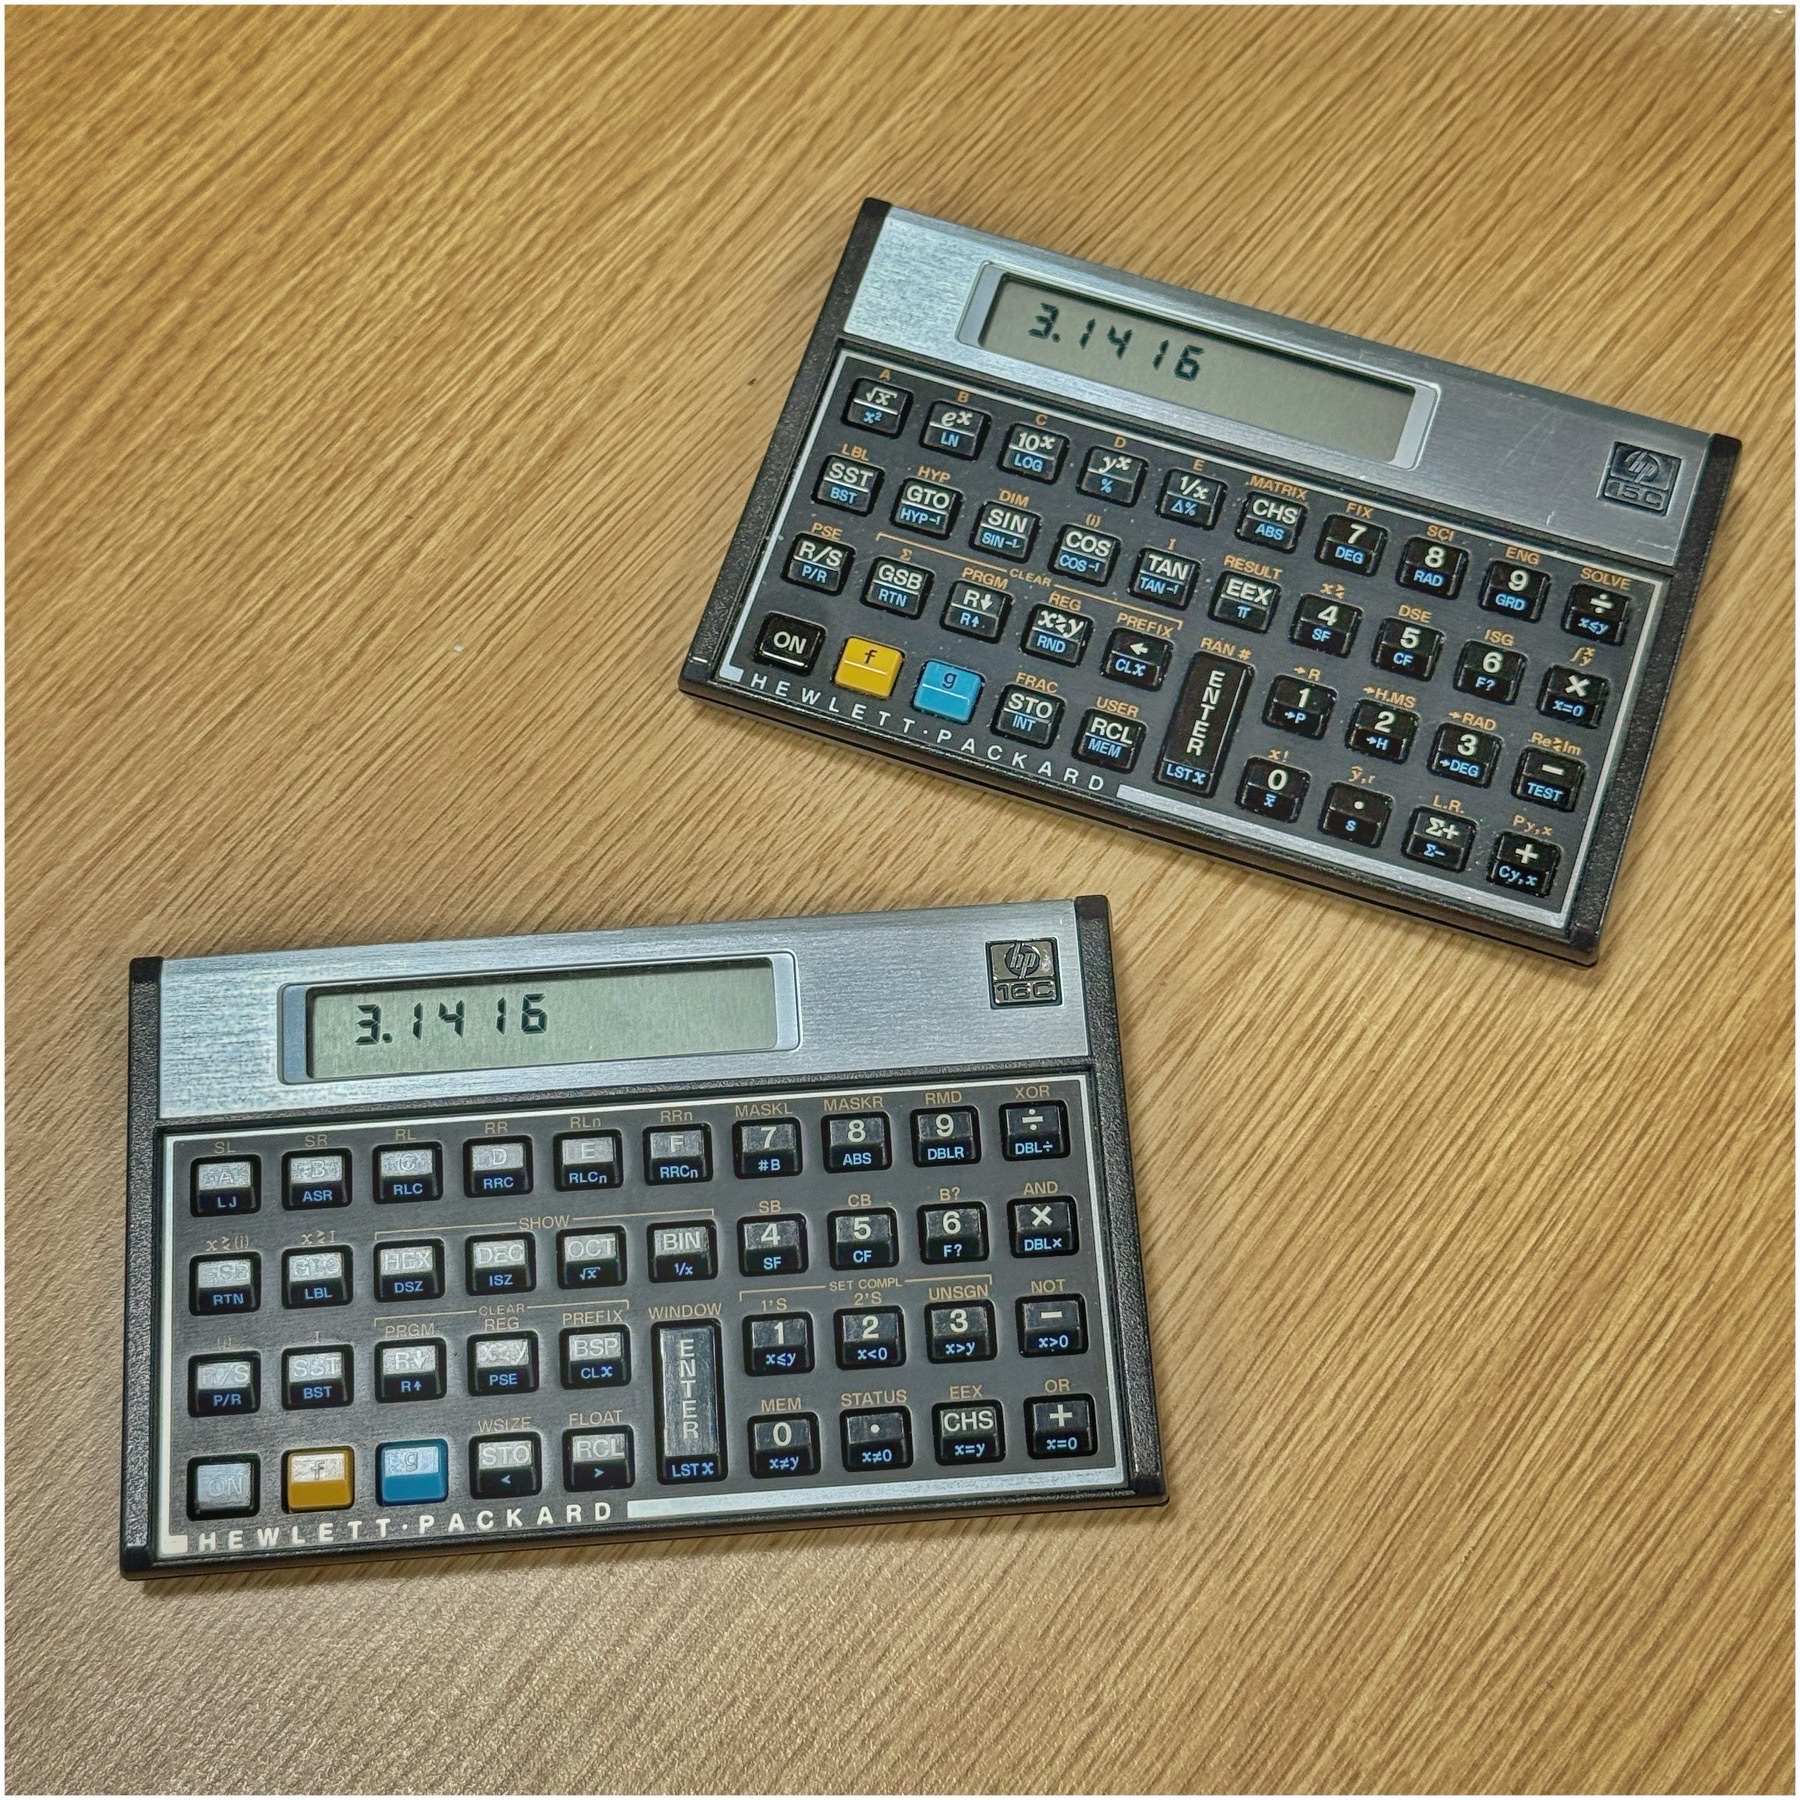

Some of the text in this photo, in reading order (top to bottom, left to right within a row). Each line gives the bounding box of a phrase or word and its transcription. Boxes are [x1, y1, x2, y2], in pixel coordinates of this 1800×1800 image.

[1028, 302, 1204, 382] 3.1416
[880, 369, 891, 381] A
[958, 391, 969, 402] B
[1035, 415, 1048, 426] C
[940, 433, 959, 447] LN
[1114, 437, 1126, 448] D
[841, 443, 870, 461] LBL
[1014, 454, 1043, 472] LOG
[1193, 459, 1205, 471] E
[829, 462, 873, 486] SST
[918, 466, 950, 482] HYP
[830, 486, 857, 504] BST
[906, 486, 949, 507] GTO
[1250, 476, 1308, 500] MATRIX
[1000, 490, 1029, 507] DIM
[1253, 500, 1298, 525] CHS
[1345, 501, 1375, 519] FIX
[988, 509, 1027, 533] SIN
[811, 523, 843, 540] PSE
[1255, 524, 1285, 540] ABS
[1348, 524, 1367, 544] 7
[1426, 525, 1455, 543] SCI
[1066, 531, 1112, 557] COS
[799, 541, 842, 567] R/S
[1334, 546, 1364, 565] DEG
[1424, 546, 1444, 569] 8
[1505, 547, 1541, 565] ENG
[801, 565, 827, 583] P/R
[878, 564, 923, 589] GSB
[1148, 555, 1189, 581] TAN
[1223, 554, 1283, 581] RESULT
[962, 567, 1008, 589] PRGM
[1010, 568, 1051, 587] CLEAR
[1413, 570, 1445, 588] RAD
[1507, 570, 1530, 592] 9
[1580, 568, 1632, 591] SOLVE
[878, 588, 906, 607] RTN
[1226, 579, 1274, 606] EEX
[1050, 593, 1082, 612] REG
[1495, 593, 1526, 611] GRD
[1317, 606, 1339, 626] 4
[1398, 605, 1432, 624] DSE
[1116, 613, 1174, 638] PREFIX
[773, 631, 806, 654] ON
[1311, 628, 1331, 643] SF
[1400, 627, 1421, 649] 5
[1484, 629, 1515, 646] ISG
[1036, 637, 1066, 654] RND
[1201, 637, 1235, 658] RAN
[864, 649, 877, 664] f
[1393, 652, 1414, 667] CF
[1482, 652, 1504, 674] 6
[942, 673, 957, 688] g
[1016, 673, 1058, 693] FRAC
[1475, 677, 1496, 692] F?
[1008, 693, 1053, 720] STO
[1298, 688, 1310, 708] 1
[1096, 697, 1140, 718] USER
[1186, 670, 1226, 757] ENTER
[1012, 716, 1037, 732] INT
[1091, 717, 1134, 745] RCL
[1374, 711, 1396, 734] 2
[1088, 739, 1123, 758] MEM
[1457, 734, 1480, 756] 3
[1267, 769, 1288, 791] 0
[1527, 782, 1564, 802] TEST
[1432, 794, 1465, 814] L.R.
[1009, 943, 1037, 980] hp
[996, 981, 1055, 1001] 16C
[355, 991, 549, 1047] 3.1416
[925, 1091, 962, 1105] RMD
[1015, 1085, 1050, 1099] XOR
[735, 1102, 793, 1118] MASKL
[823, 1095, 884, 1112] MASKR
[570, 1116, 601, 1129] RLn
[660, 1109, 693, 1123] RRn
[484, 1121, 509, 1134] RR
[847, 1119, 867, 1144] 8
[935, 1113, 955, 1138] 9
[305, 1134, 328, 1148] SR
[395, 1129, 417, 1141] RL
[669, 1135, 684, 1153] F
[760, 1126, 778, 1150] 7
[214, 1142, 235, 1154] SL
[493, 1149, 507, 1165] D
[580, 1143, 596, 1160] E
[927, 1146, 965, 1161] DBLR
[842, 1151, 872, 1166] ABS
[569, 1171, 607, 1185] RLCn
[660, 1165, 698, 1179] RRCn
[393, 1183, 423, 1196] RLC
[483, 1176, 514, 1189] RRC
[1023, 1181, 1059, 1195] AND
[217, 1196, 238, 1208] LJ
[302, 1190, 333, 1203] ASR
[848, 1194, 872, 1207] CB
[939, 1186, 961, 1201] B?
[758, 1200, 782, 1214] SB
[518, 1214, 570, 1230] SHOW
[853, 1217, 872, 1241] 5
[942, 1211, 962, 1235] 6
[663, 1231, 700, 1251] BIN
[760, 1223, 780, 1248] 4
[567, 1238, 615, 1258] OCT
[943, 1244, 963, 1258] F?
[384, 1247, 430, 1270] HEX
[763, 1257, 782, 1270] SF
[853, 1251, 873, 1264] CF
[394, 1280, 423, 1294] DSZ
[489, 1273, 513, 1286] ISZ
[829, 1276, 904, 1292] SET COMPL
[1030, 1278, 1067, 1294] NOT
[212, 1293, 244, 1306] RTN
[305, 1287, 332, 1300] LBL
[928, 1284, 989, 1301] UNSGN
[479, 1303, 525, 1316] CLEAR
[562, 1310, 623, 1325] PREFIX
[648, 1302, 722, 1319] WINDOW
[484, 1317, 520, 1331] REG
[862, 1315, 879, 1340] 2
[950, 1308, 969, 1333] 3
[384, 1323, 435, 1338] PRGM
[773, 1322, 785, 1345] 1
[573, 1339, 618, 1357] BSP
[489, 1373, 518, 1386] PSE
[1043, 1378, 1071, 1394] OR
[303, 1386, 333, 1399] BST
[679, 1339, 699, 1439] ENTER
[840, 1389, 908, 1407] STATUS
[949, 1385, 984, 1400] EEX
[213, 1394, 242, 1406] P/R
[760, 1397, 802, 1413] MEM
[478, 1416, 532, 1432] WSIZE
[569, 1410, 623, 1425] FLOAT
[943, 1410, 994, 1433] CHS
[773, 1421, 792, 1447] 0
[480, 1445, 529, 1466] STO
[576, 1439, 625, 1459] RCL
[404, 1450, 419, 1470] g
[310, 1459, 326, 1480] f
